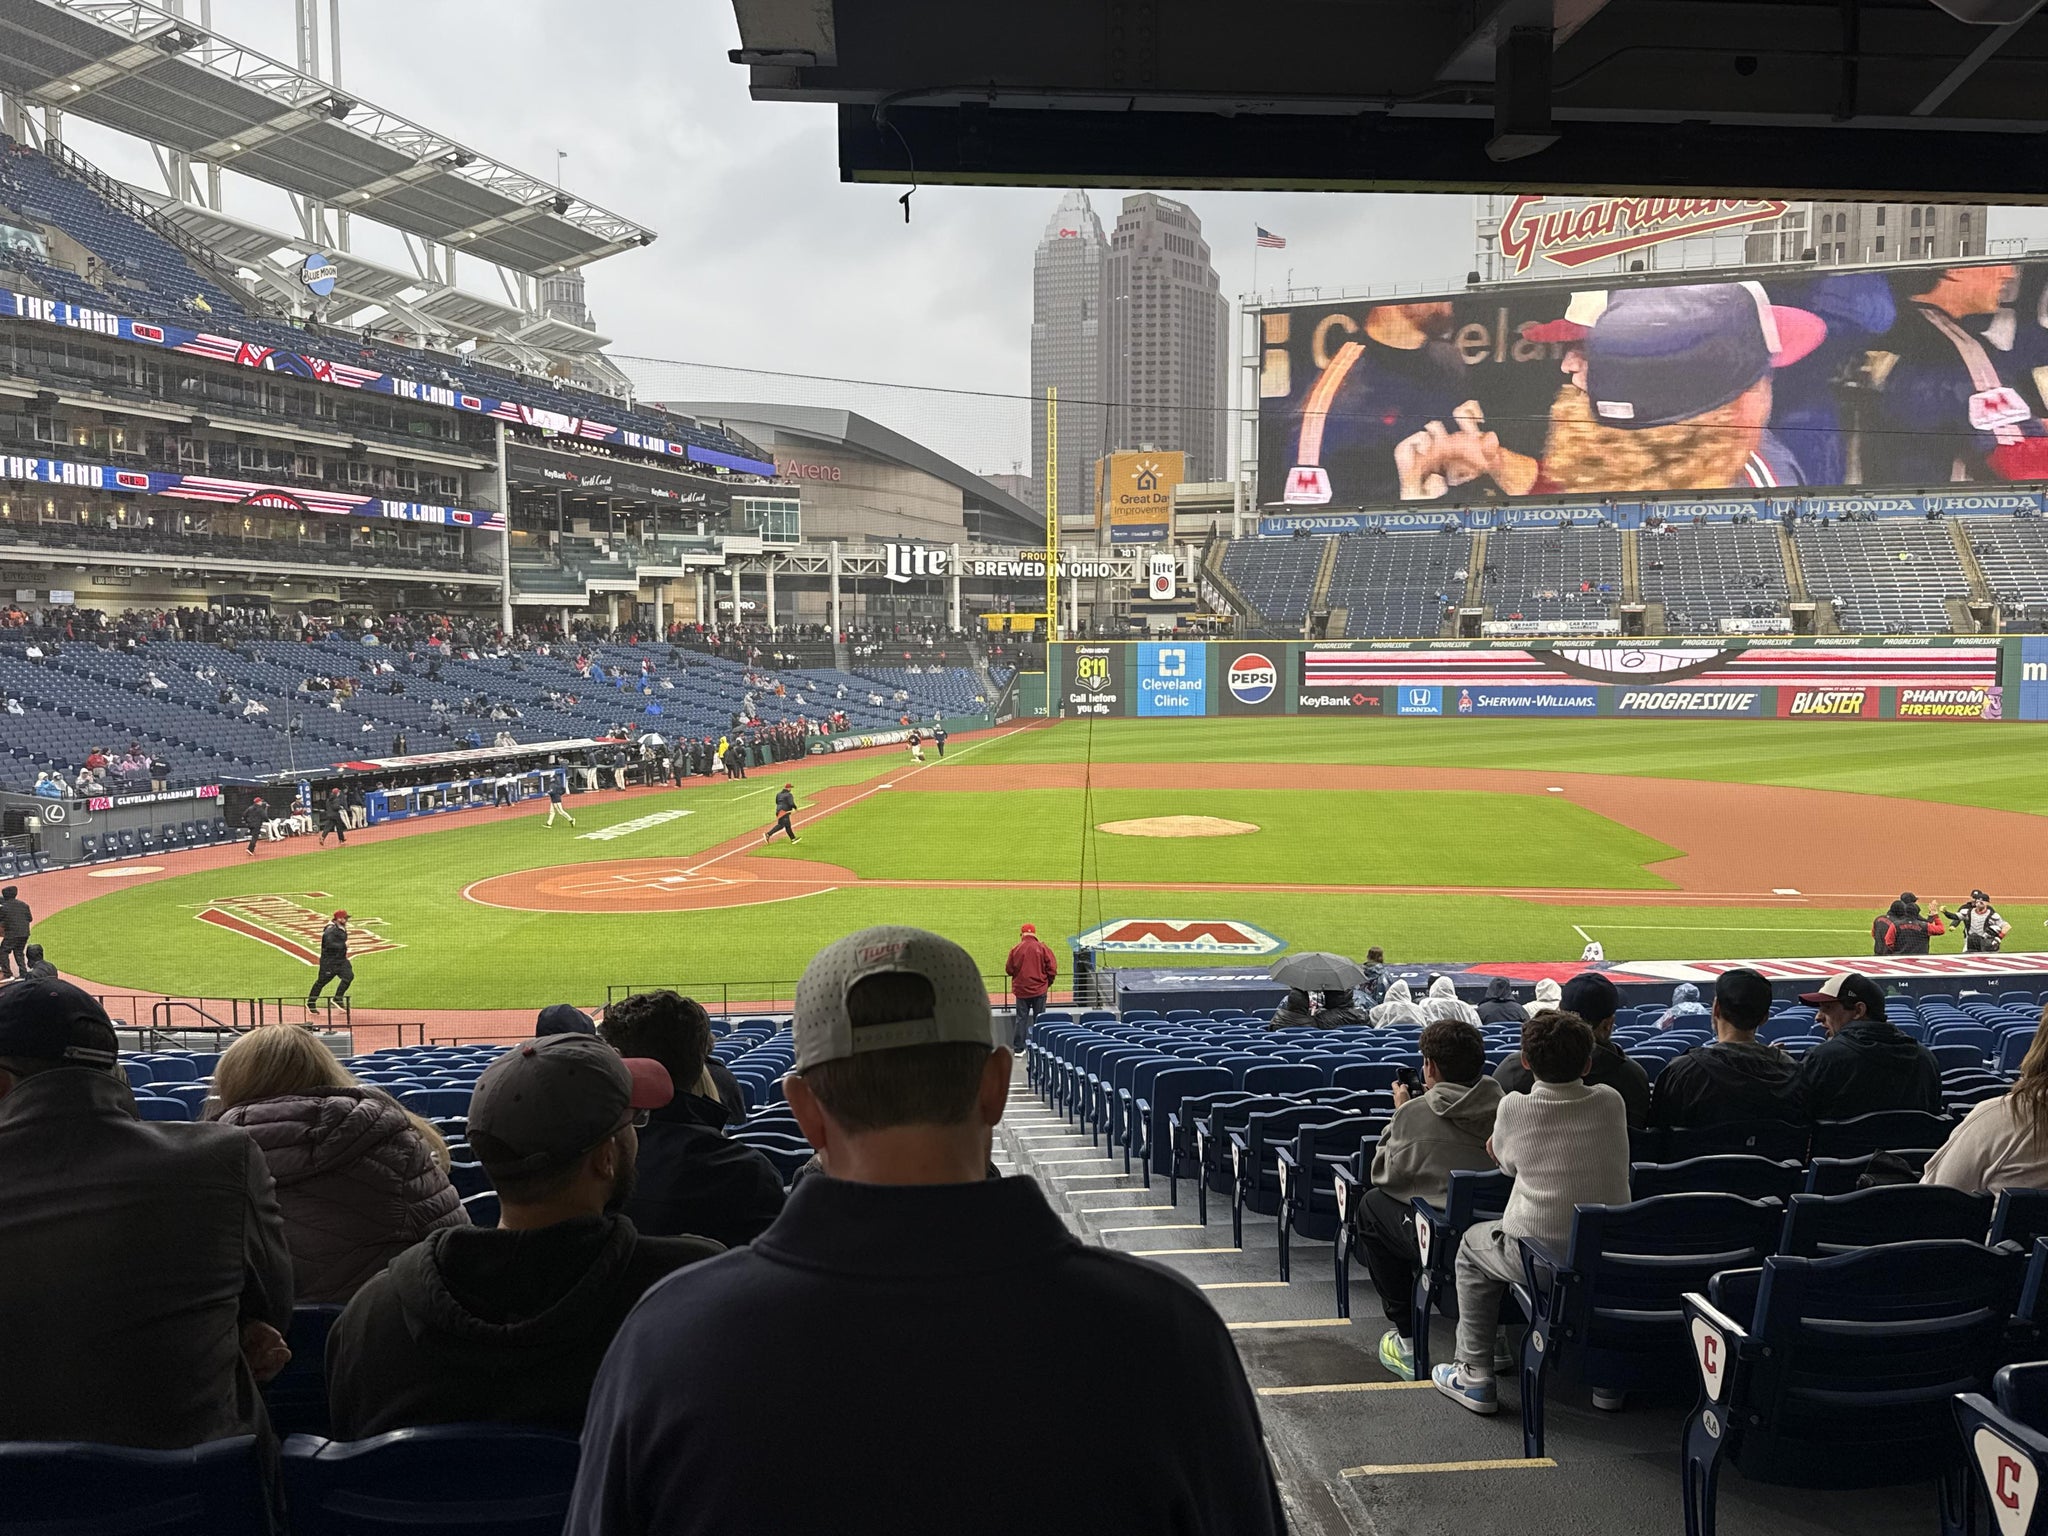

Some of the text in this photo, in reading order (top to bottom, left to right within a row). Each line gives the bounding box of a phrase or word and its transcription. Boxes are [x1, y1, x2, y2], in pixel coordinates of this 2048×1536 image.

[320, 267, 337, 278] MOON
[13, 293, 56, 322] THE
[65, 305, 119, 336] LAND
[391, 377, 417, 398] THE
[421, 384, 455, 407] LAND
[623, 431, 640, 448] THE
[642, 436, 665, 453] LAND
[0, 456, 39, 480] THE
[48, 461, 103, 487] LAND
[544, 469, 567, 480] KeyBank
[786, 460, 840, 481] Arena
[1120, 494, 1151, 504] Great
[1951, 497, 2037, 508] HONDA
[381, 500, 408, 519] THE
[412, 504, 445, 523] LAND
[1114, 506, 1169, 516] Improveme
[1672, 504, 1758, 517] HONDA
[1827, 499, 1916, 513] HONDA
[1384, 513, 1461, 526] HONDA
[1524, 509, 1605, 521] HONDA
[1286, 517, 1359, 529] HONDA
[1020, 551, 1065, 561] PROUDLY
[883, 543, 948, 584] Lite
[974, 561, 1046, 577] BREWED
[1070, 563, 1111, 577] OHIO
[1152, 562, 1173, 576] Lite
[1079, 658, 1107, 678] 811
[1142, 678, 1202, 690] Cleveland
[1231, 673, 1274, 684] PEPSI
[1070, 693, 1117, 703] Call before
[1154, 695, 1189, 707] Clinic
[1300, 695, 1351, 708] KeyBank
[1619, 692, 1754, 711] PROGRESSIVE
[1902, 690, 1984, 703] PHANTOM
[1034, 707, 1047, 715] 325
[1077, 704, 1110, 714] you dig.
[1900, 704, 1982, 716] FIREWORKS
[117, 793, 156, 806] CLEVELAND
[157, 789, 194, 800] GUARDIANS
[1097, 942, 1262, 951] Marathon
[1704, 1335, 1717, 1374] C
[1705, 1415, 1718, 1436] AA
[1996, 1456, 2021, 1509] C
